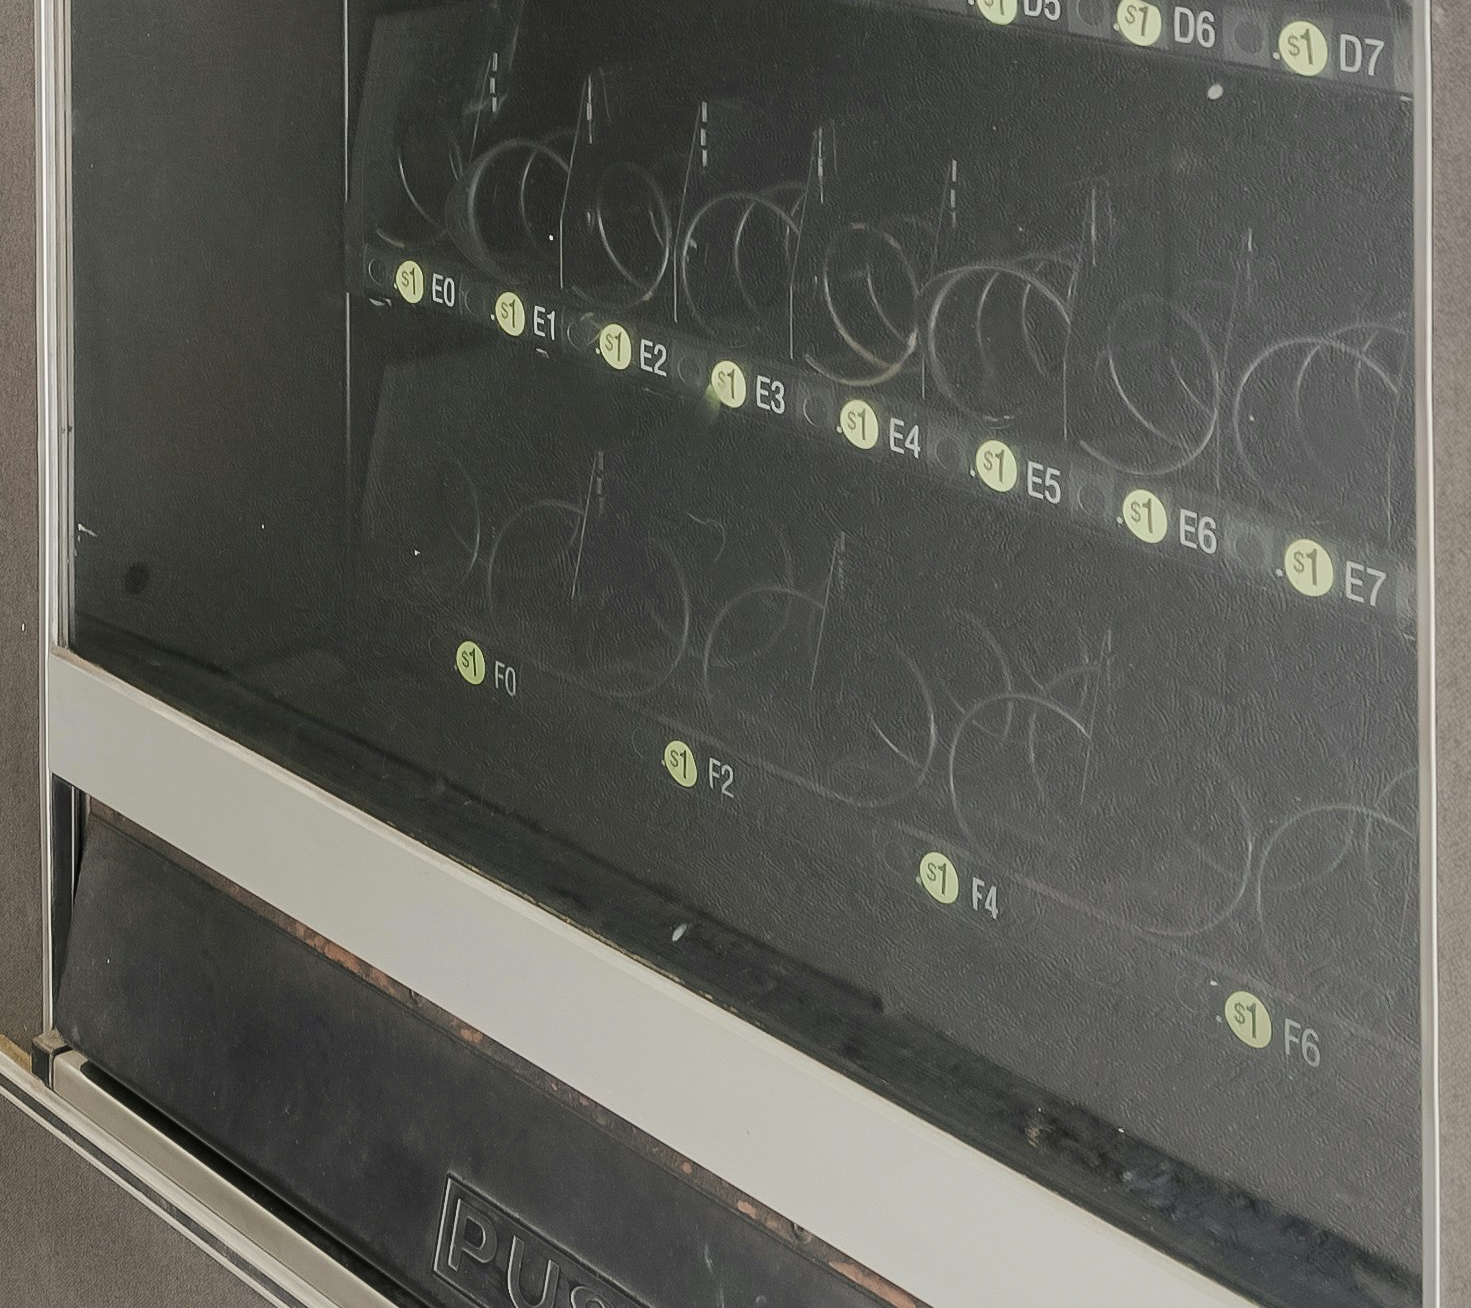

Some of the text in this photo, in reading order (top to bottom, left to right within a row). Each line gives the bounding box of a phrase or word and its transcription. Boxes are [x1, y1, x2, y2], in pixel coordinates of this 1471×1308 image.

[1124, 4, 1216, 49] $1 D6
[1287, 28, 1385, 77] $1 D7
[401, 268, 455, 307] $1 E0
[500, 300, 556, 341] $1 E1
[604, 332, 668, 377] $1 E2
[717, 369, 785, 414] $1 E3
[847, 408, 922, 459] $1 E4
[983, 449, 1062, 504] $1 E5
[1130, 498, 1217, 554] $1 E6
[1293, 548, 1387, 607] $1 E7
[461, 649, 516, 696] $1 F0
[669, 749, 735, 798] $1 F2
[926, 862, 999, 920] $1 F4
[1234, 1002, 1321, 1068] $1 F6
